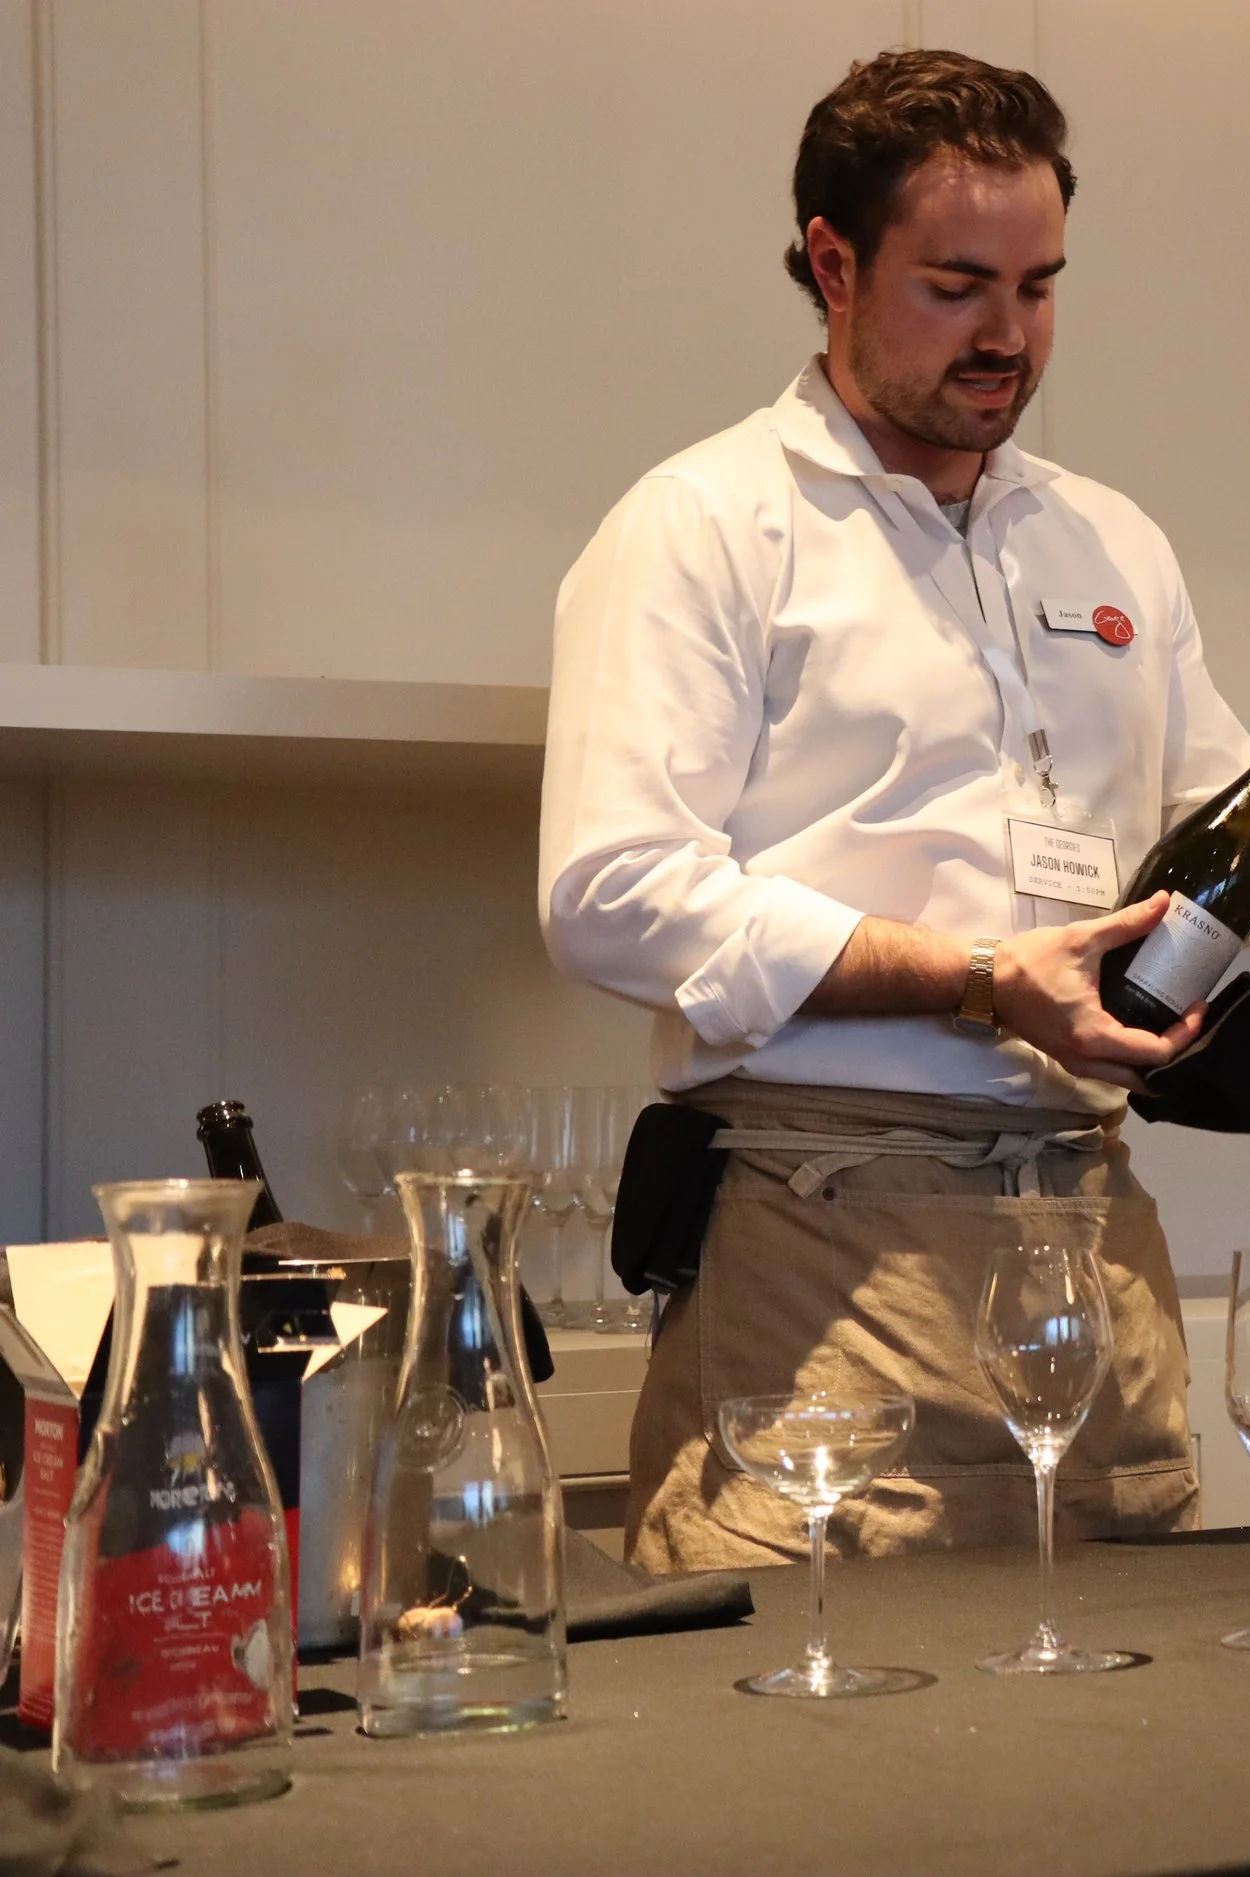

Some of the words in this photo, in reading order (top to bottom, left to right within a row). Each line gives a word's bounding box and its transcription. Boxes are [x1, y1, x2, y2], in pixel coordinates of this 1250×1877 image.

[1058, 610, 1082, 619] Jason
[1030, 854, 1061, 872] JASON
[1063, 860, 1100, 879] HOWICK
[1028, 876, 1062, 889] SERVICE
[1174, 904, 1220, 940] KRASNO
[128, 1590, 164, 1614] ICE
